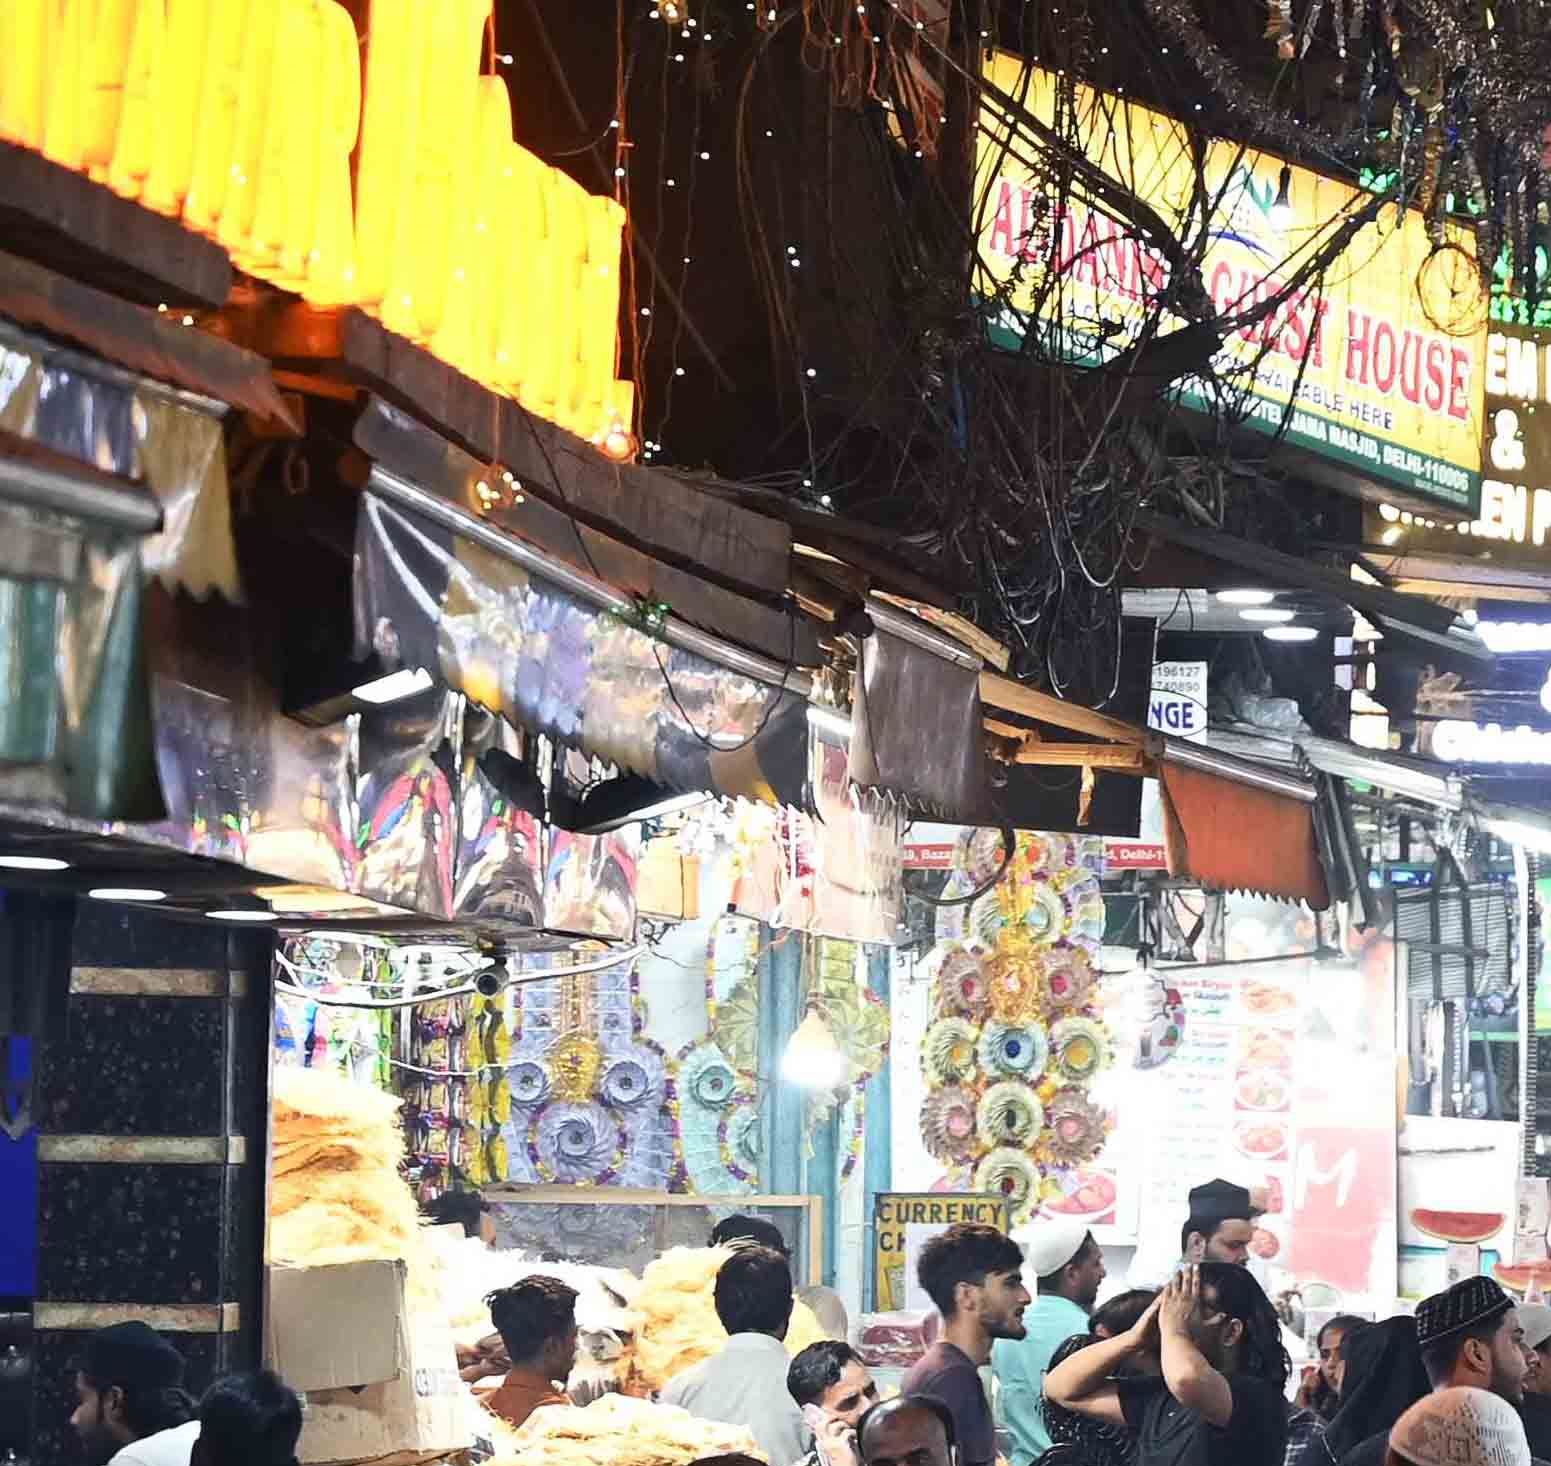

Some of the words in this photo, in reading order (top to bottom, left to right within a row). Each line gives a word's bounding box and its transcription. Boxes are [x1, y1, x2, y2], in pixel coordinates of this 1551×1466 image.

[1346, 310, 1470, 420] HOUSE
[1350, 400, 1393, 431] HERE
[1490, 409, 1526, 470] &
[879, 1201, 1002, 1225] CURRENCY
